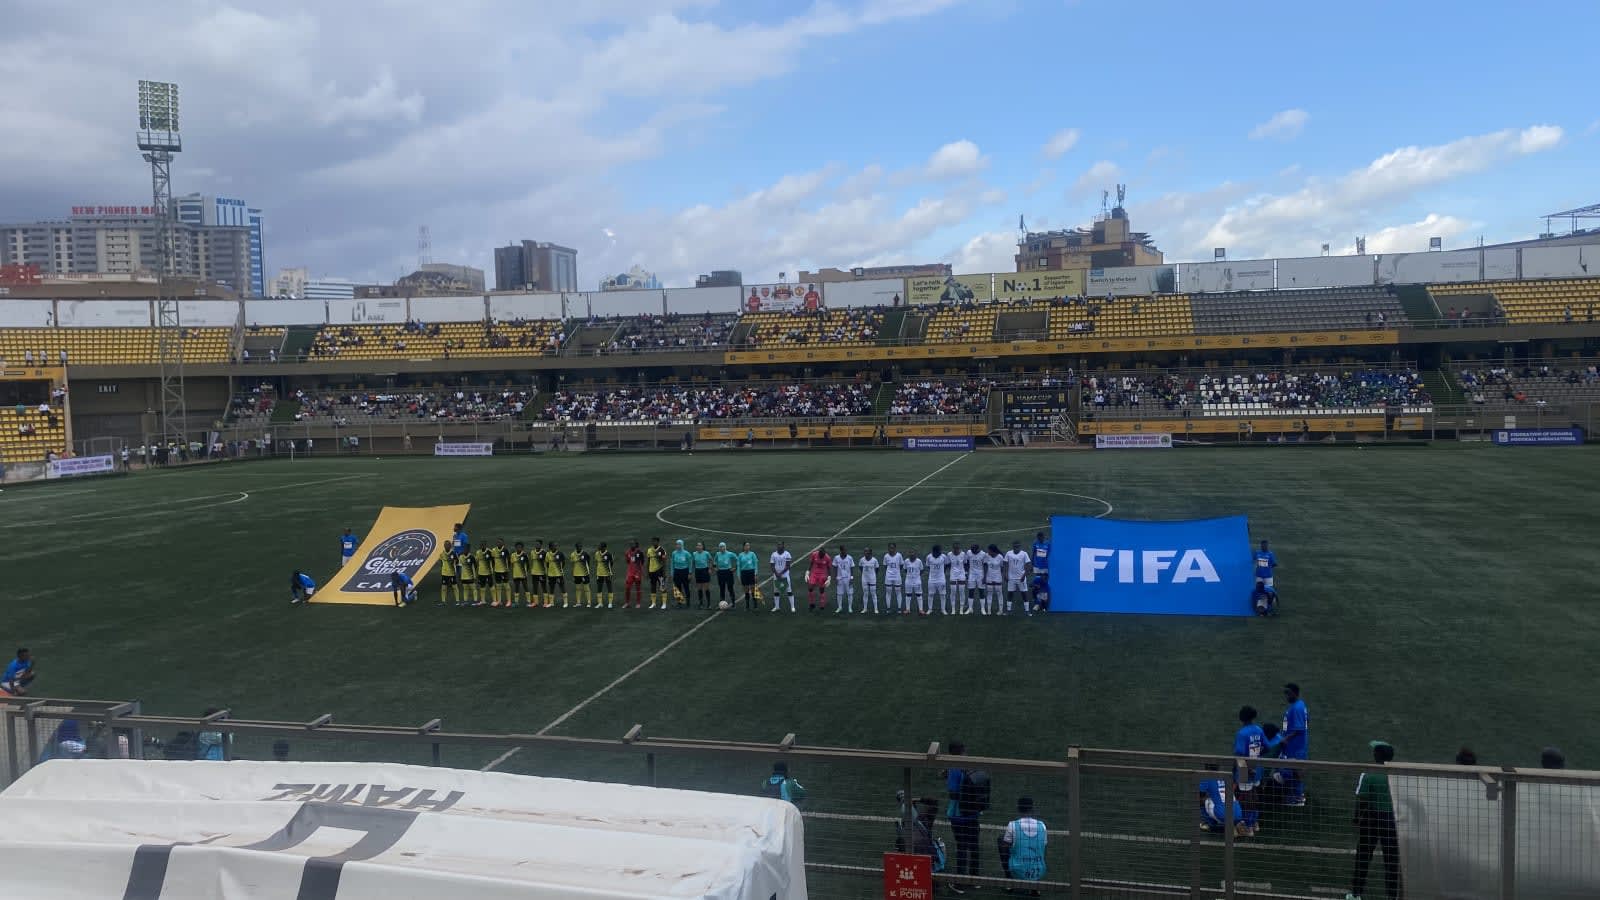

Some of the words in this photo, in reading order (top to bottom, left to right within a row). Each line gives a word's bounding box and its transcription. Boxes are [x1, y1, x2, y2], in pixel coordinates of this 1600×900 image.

[72, 206, 95, 215] NEW
[98, 206, 138, 215] PIONEER
[98, 385, 116, 393] EXIT
[365, 556, 424, 570] Celebrate
[1080, 547, 1220, 583] FIFA
[367, 565, 407, 575] Africa
[265, 783, 466, 812] HAMZ
[900, 891, 929, 900] POINT
